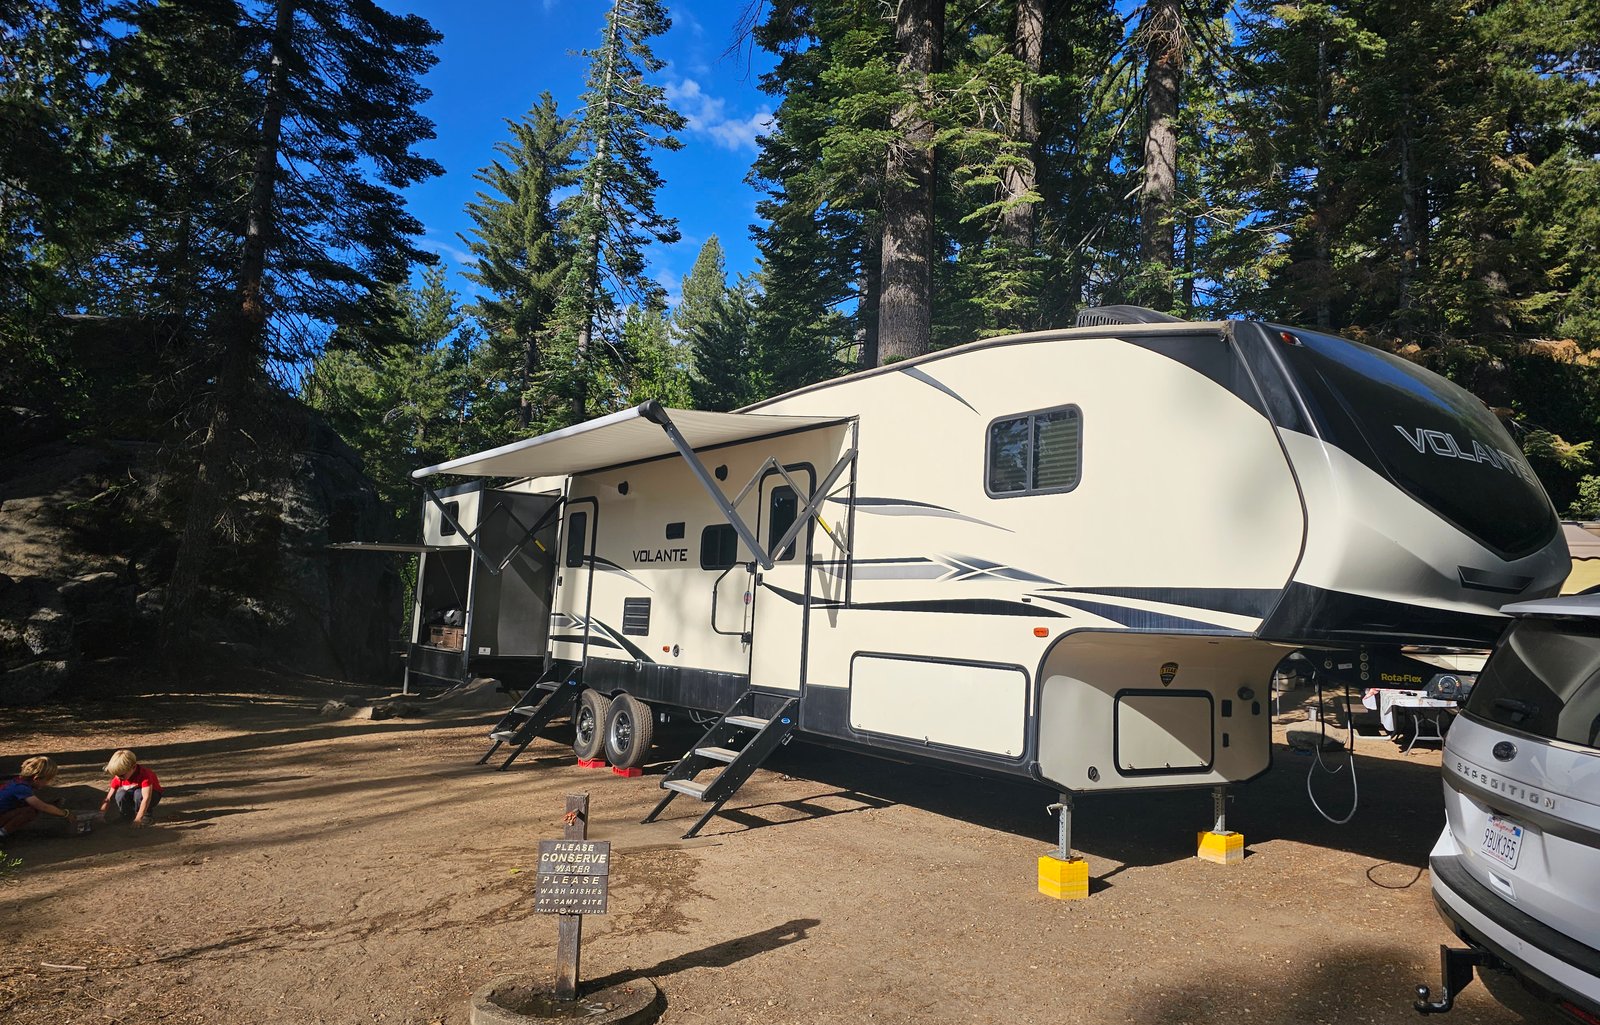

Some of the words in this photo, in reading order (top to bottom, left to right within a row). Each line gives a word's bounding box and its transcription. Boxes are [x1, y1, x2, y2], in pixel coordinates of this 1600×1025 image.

[632, 549, 688, 562] VOLANTE
[1381, 673, 1422, 683] Rota-Flex
[1456, 762, 1556, 810] EXPEDITION
[554, 843, 595, 852] PLEASE
[1482, 828, 1517, 861] 9BUK355
[541, 853, 607, 864] CONSERVE
[554, 864, 591, 873] WATER
[542, 875, 600, 885] PLEASE
